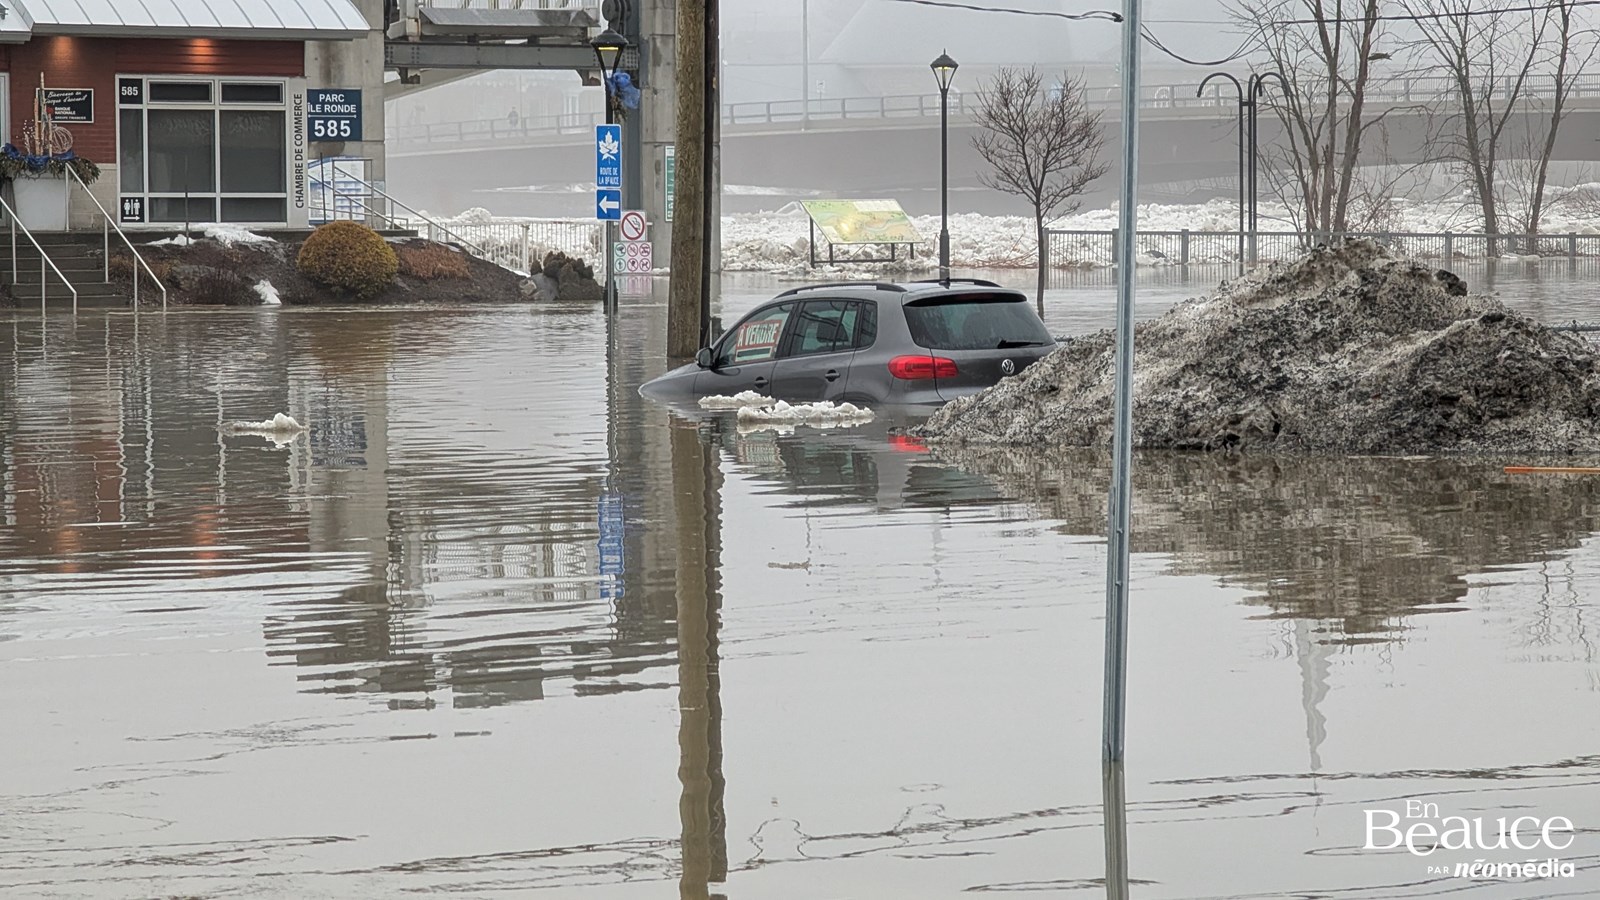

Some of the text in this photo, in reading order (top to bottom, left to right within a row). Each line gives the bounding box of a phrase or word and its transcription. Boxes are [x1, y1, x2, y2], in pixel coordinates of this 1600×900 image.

[121, 86, 139, 96] 585
[319, 94, 345, 103] PARC
[307, 102, 357, 113] ÎLE RONDE
[314, 120, 351, 137] 585
[294, 93, 304, 208] CHAMBRE DE COMMERCE
[600, 167, 618, 176] ROUTE DE
[599, 176, 604, 184] LA
[745, 323, 779, 346] VENDRE
